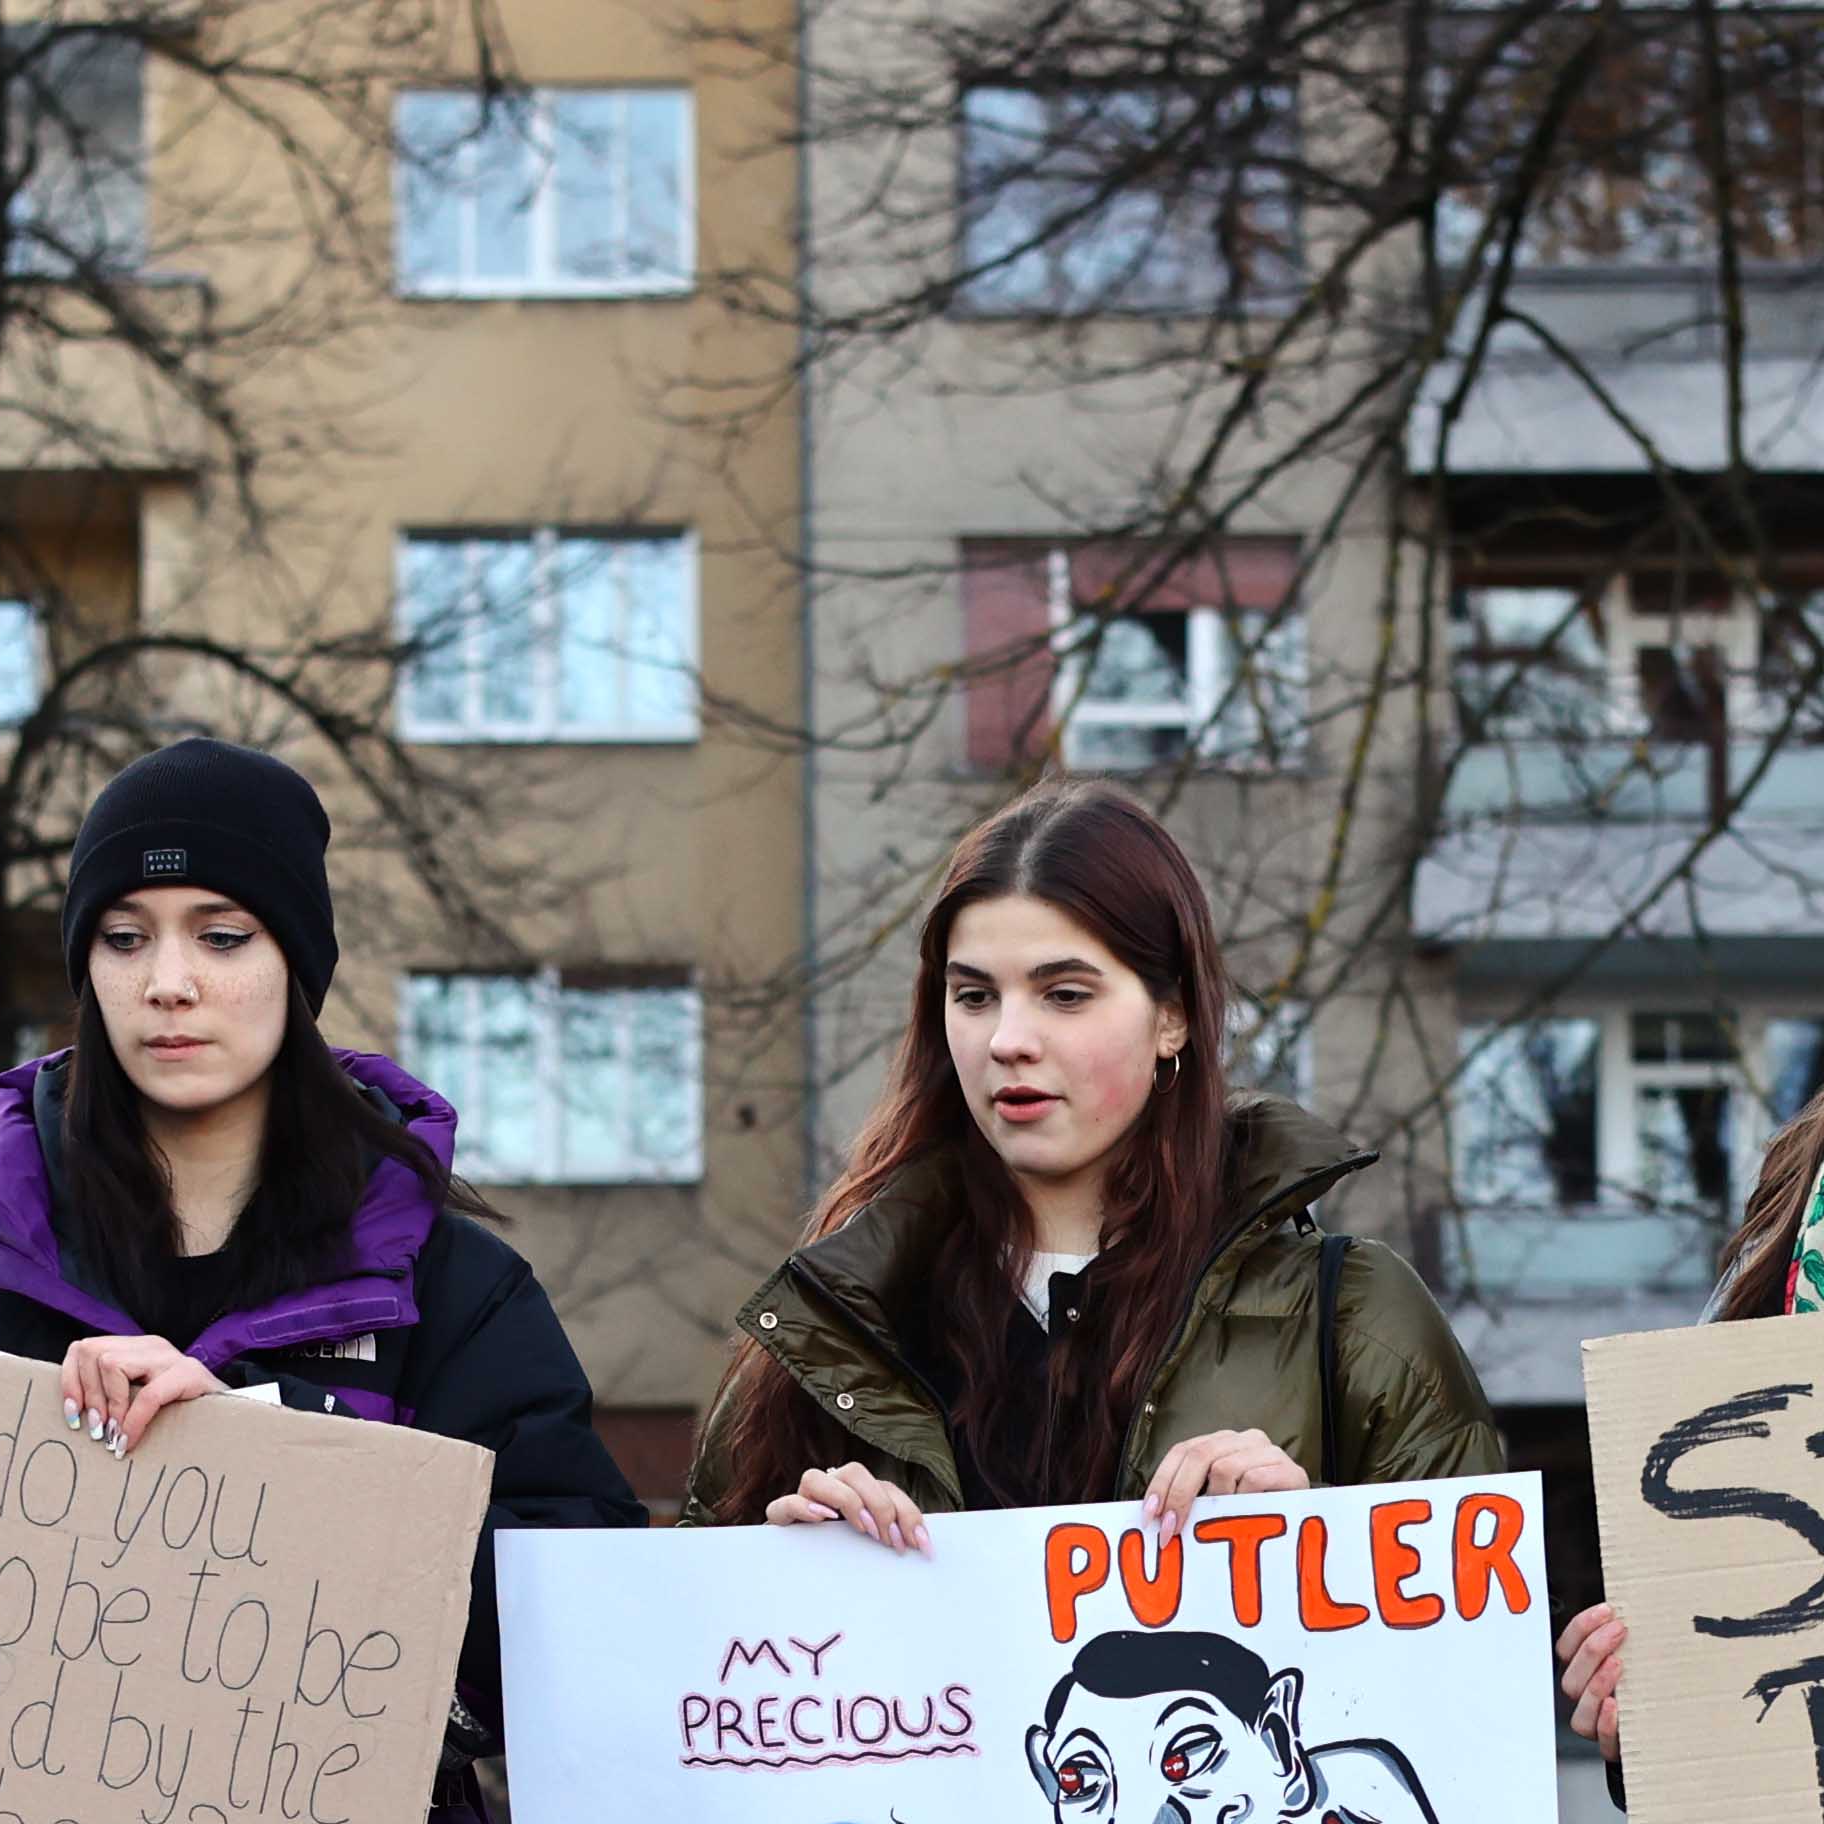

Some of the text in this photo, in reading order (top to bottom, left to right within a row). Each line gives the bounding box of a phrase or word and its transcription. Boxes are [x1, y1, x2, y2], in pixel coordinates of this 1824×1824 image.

[101, 1456, 269, 1569] you
[1044, 1492, 1533, 1644] PUTLER
[180, 1558, 271, 1691] to
[294, 1577, 402, 1718] be
[719, 1632, 843, 1685] MY
[681, 1684, 976, 1752] PRECIOUS
